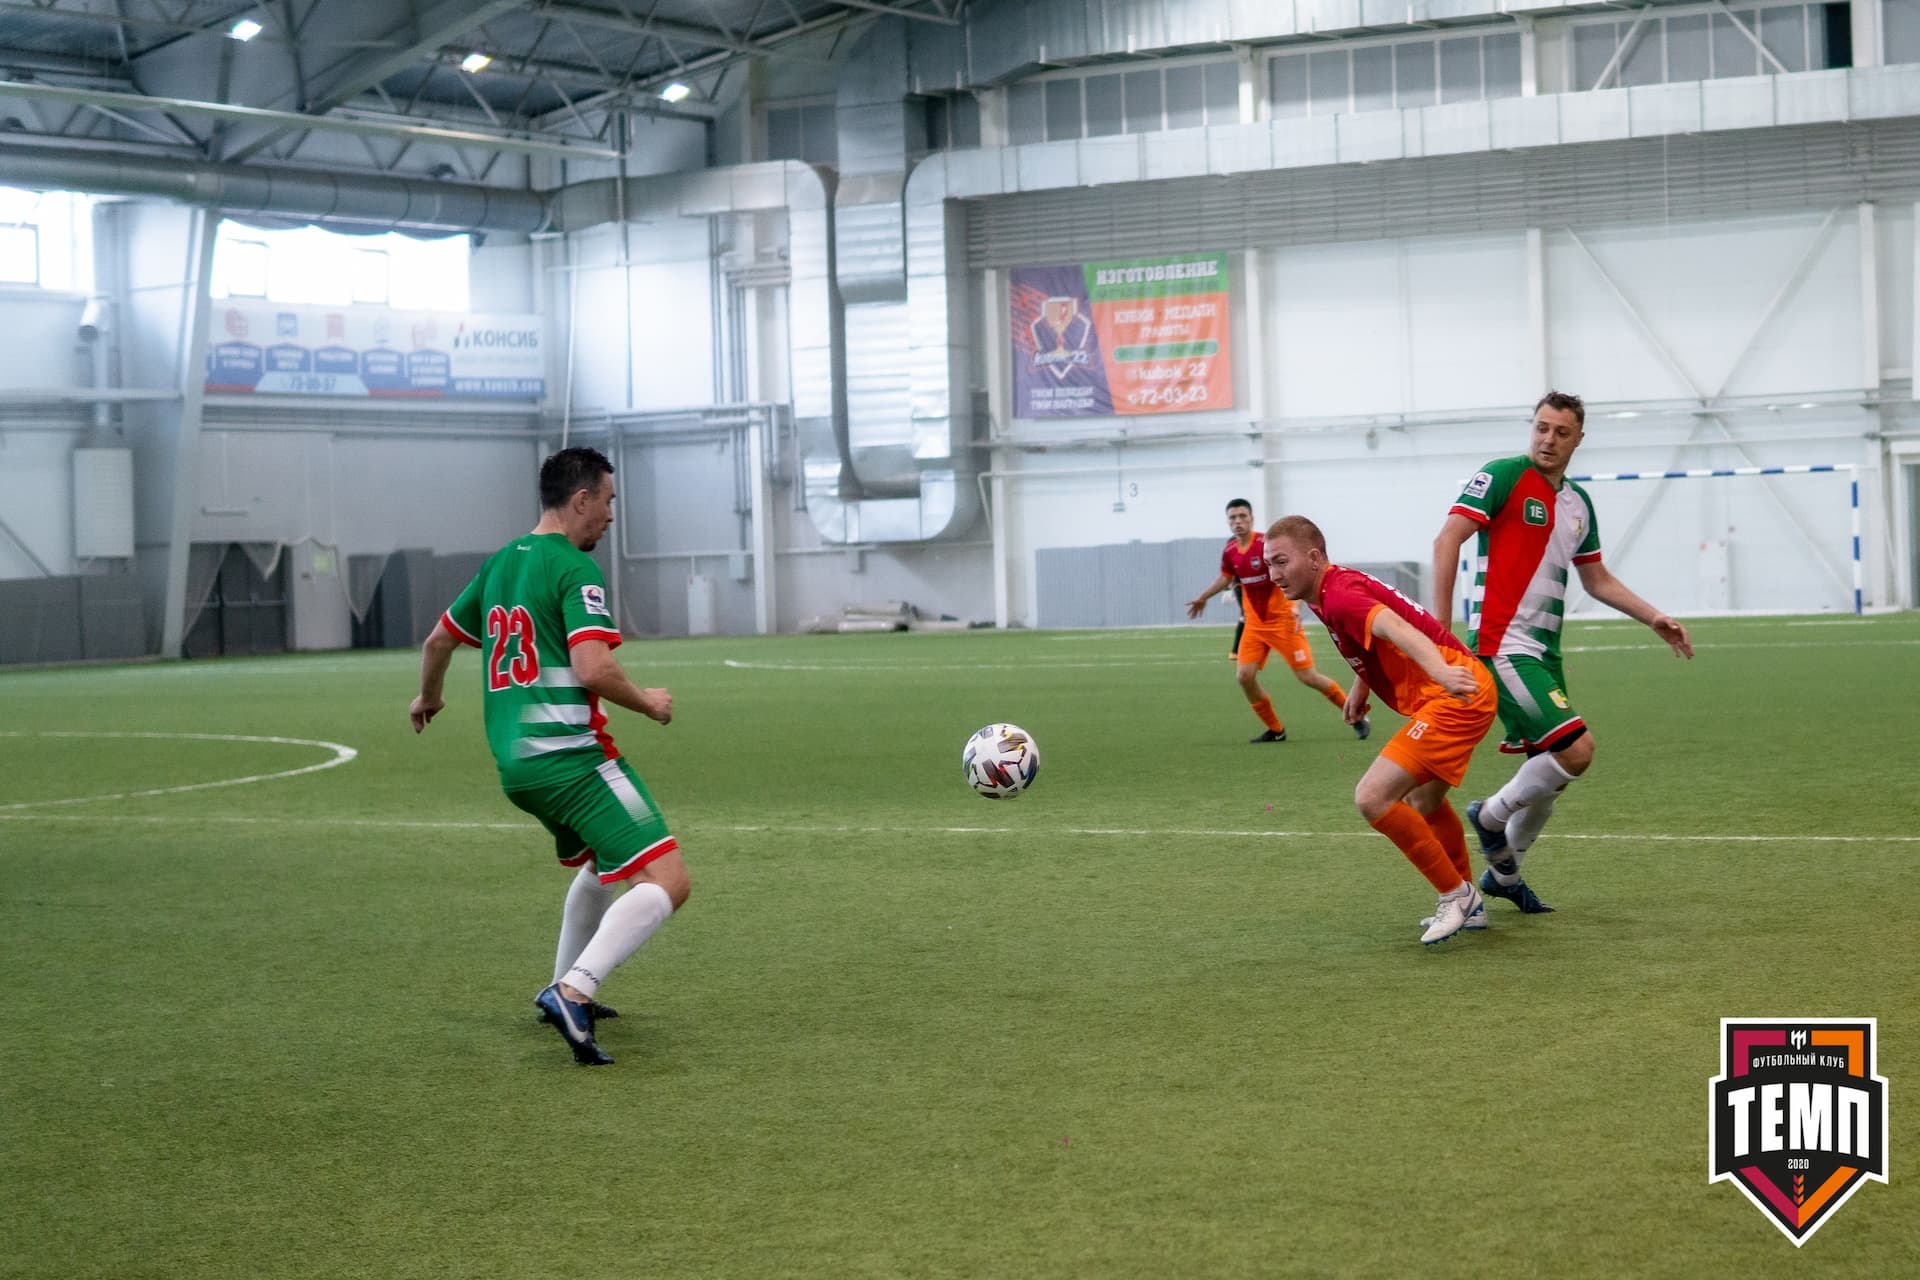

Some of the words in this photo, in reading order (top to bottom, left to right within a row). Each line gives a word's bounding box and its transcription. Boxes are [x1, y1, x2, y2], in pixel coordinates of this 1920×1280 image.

[1096, 260, 1218, 286] ИЗГОТОВЛЕНИЕ
[473, 330, 538, 348] КОНСИБ
[1140, 384, 1208, 404] 72-03-23
[1129, 482, 1138, 497] 3
[487, 605, 541, 692] 23
[1407, 720, 1428, 740] 15
